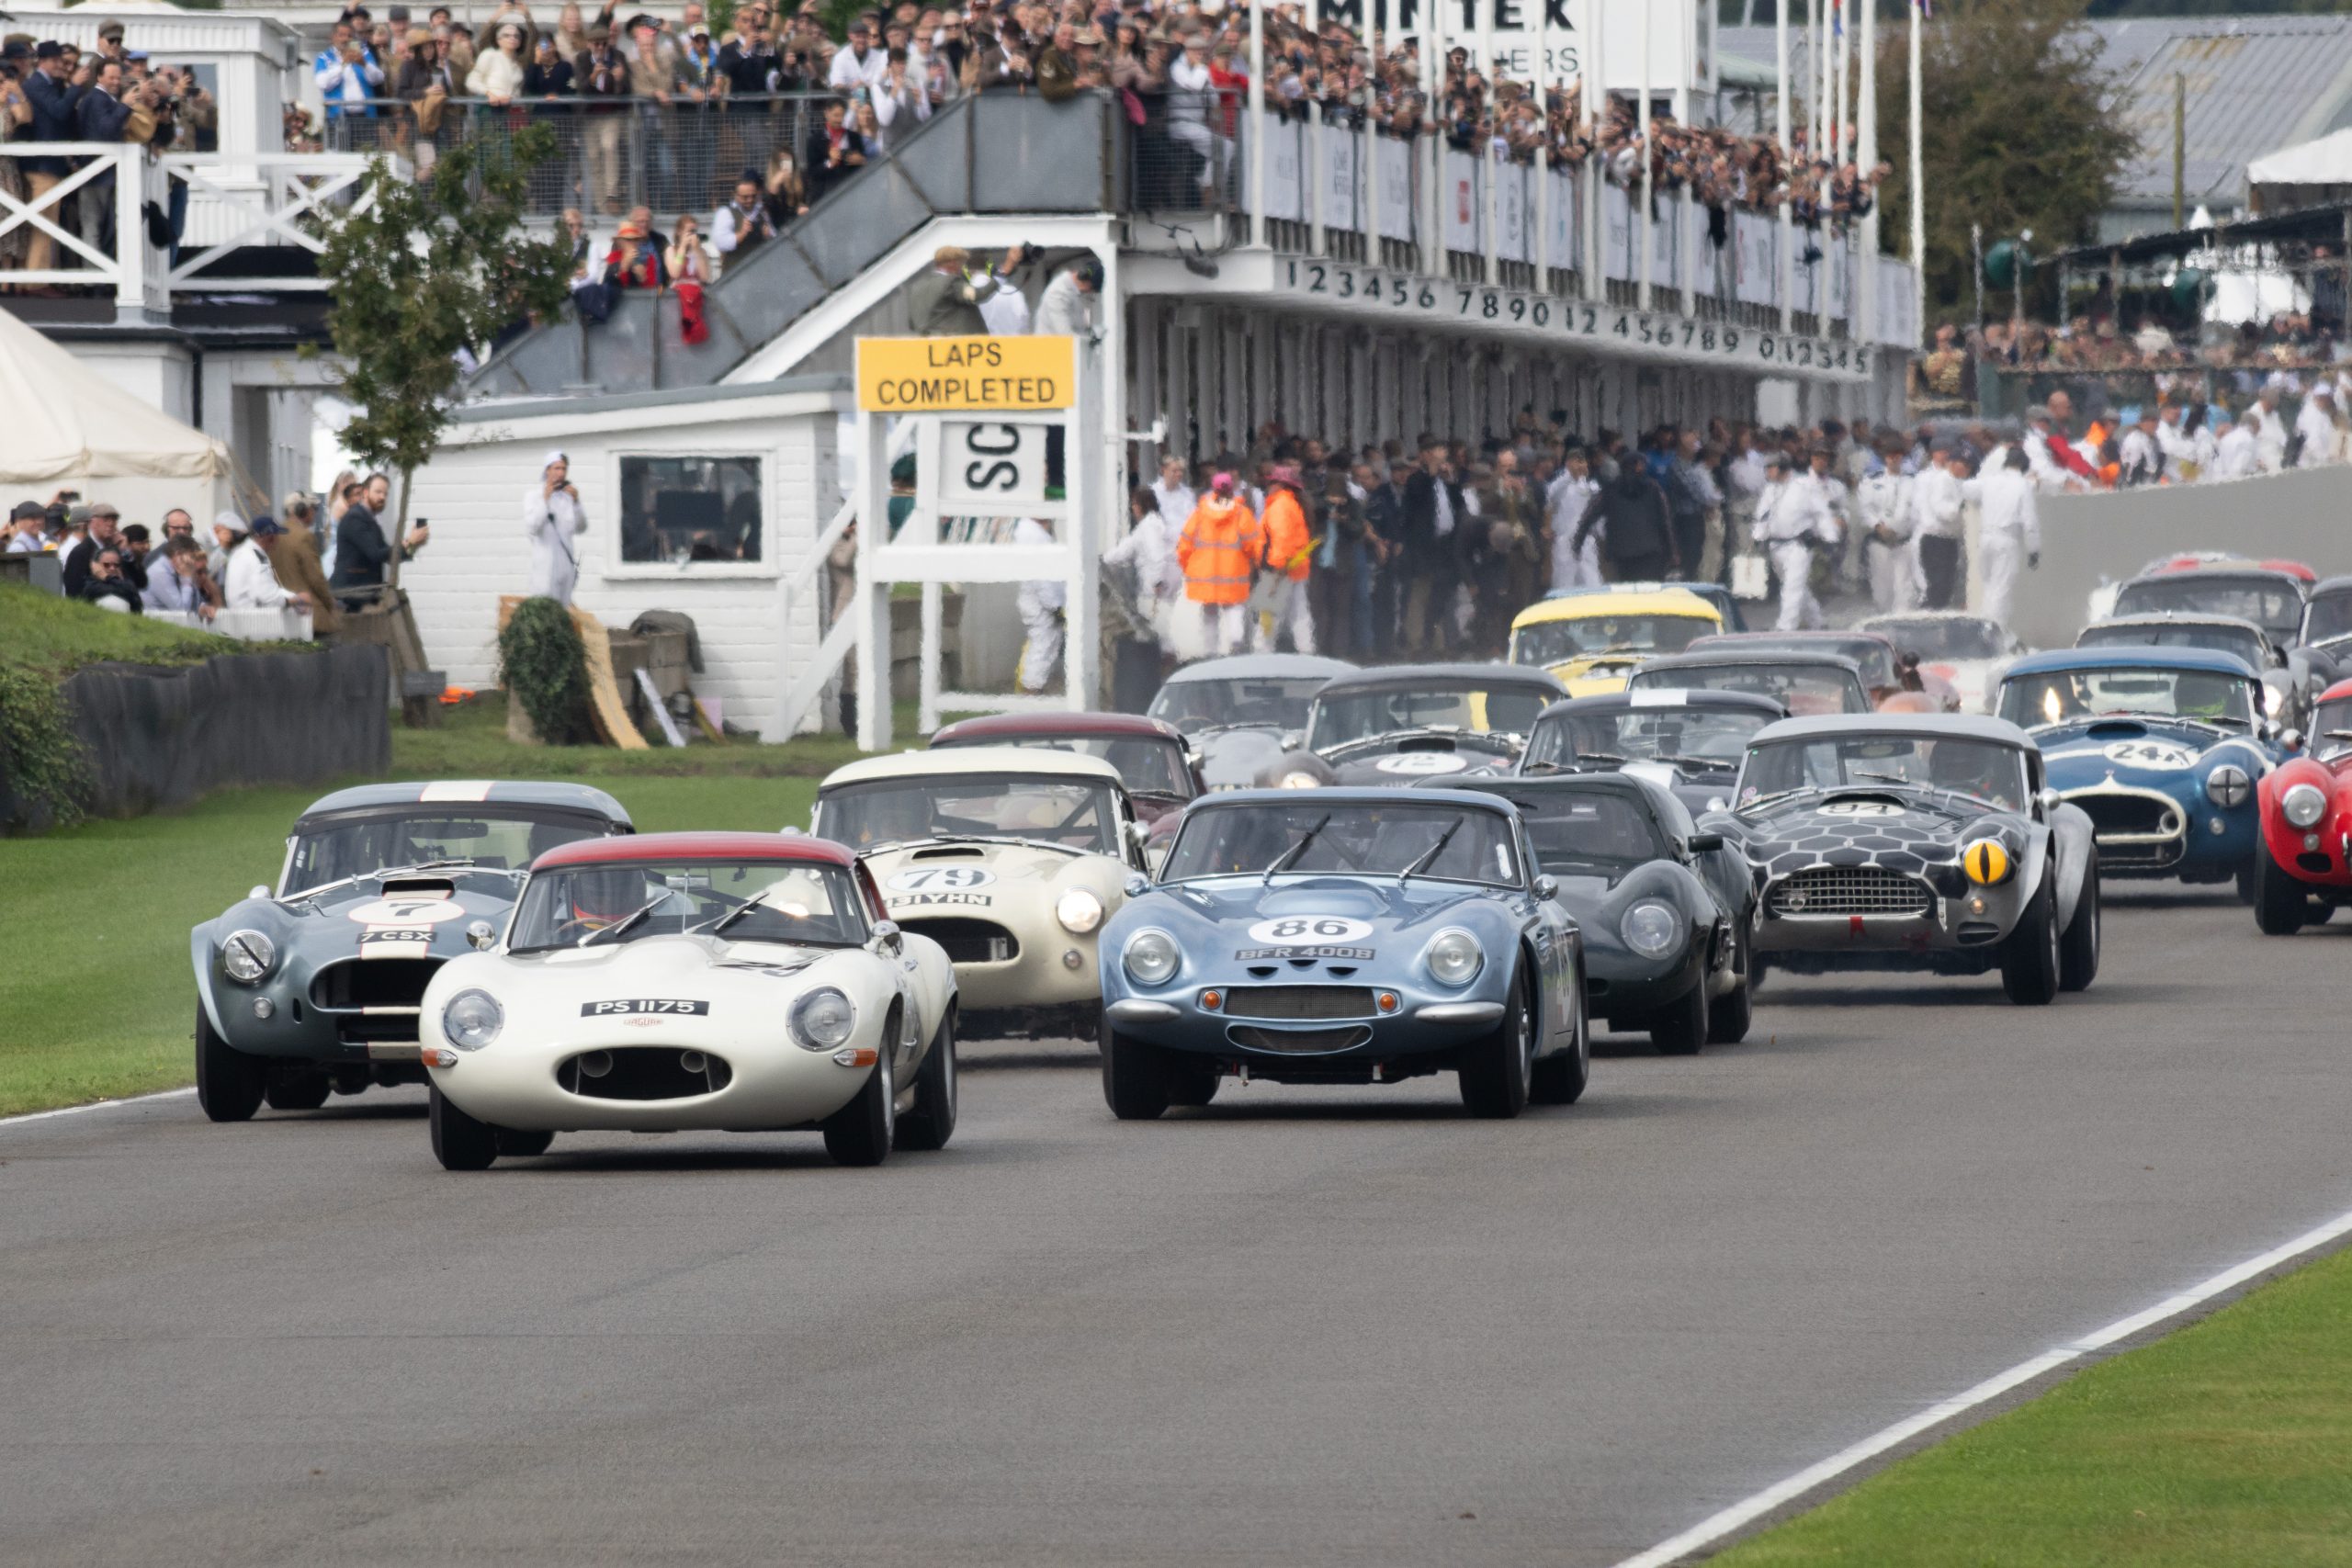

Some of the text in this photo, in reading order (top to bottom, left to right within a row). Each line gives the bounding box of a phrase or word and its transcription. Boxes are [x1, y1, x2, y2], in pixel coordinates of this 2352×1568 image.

[927, 342, 1002, 368] LAPS
[877, 378, 1056, 405] COMPLETED
[904, 868, 986, 889] 79
[389, 902, 437, 917] 7
[1272, 919, 1350, 937] 86
[359, 931, 434, 942] 7 CSX
[1239, 947, 1373, 960] BFR 400B
[595, 999, 695, 1014] PS 1175
